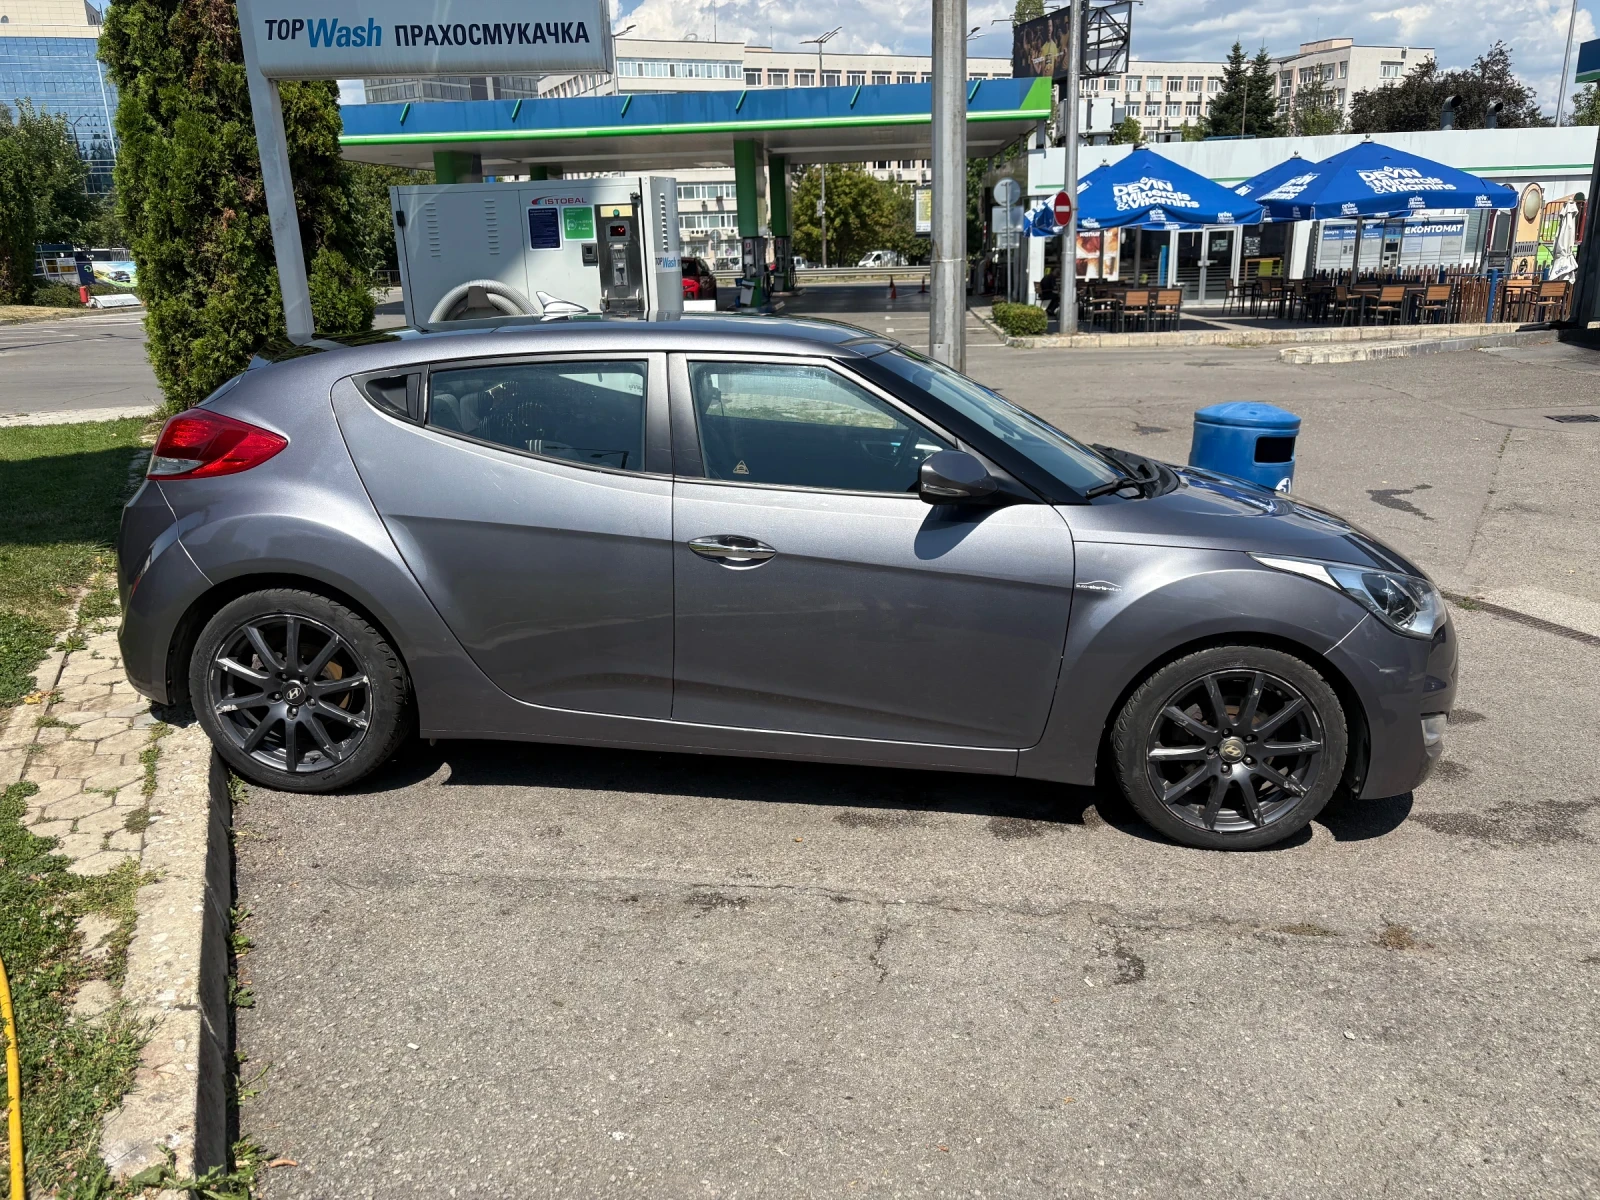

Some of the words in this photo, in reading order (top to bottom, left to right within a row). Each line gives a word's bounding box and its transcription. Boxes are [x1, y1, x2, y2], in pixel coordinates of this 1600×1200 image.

[394, 21, 590, 47] ПРАХОСМУКАЧКА
[1357, 168, 1423, 182] DEVIN
[1113, 178, 1174, 196] DEVIN
[544, 197, 588, 205] ISTOBAL
[1121, 189, 1191, 203] Minerals
[1404, 224, 1463, 234] ЕКОНТОМАТ
